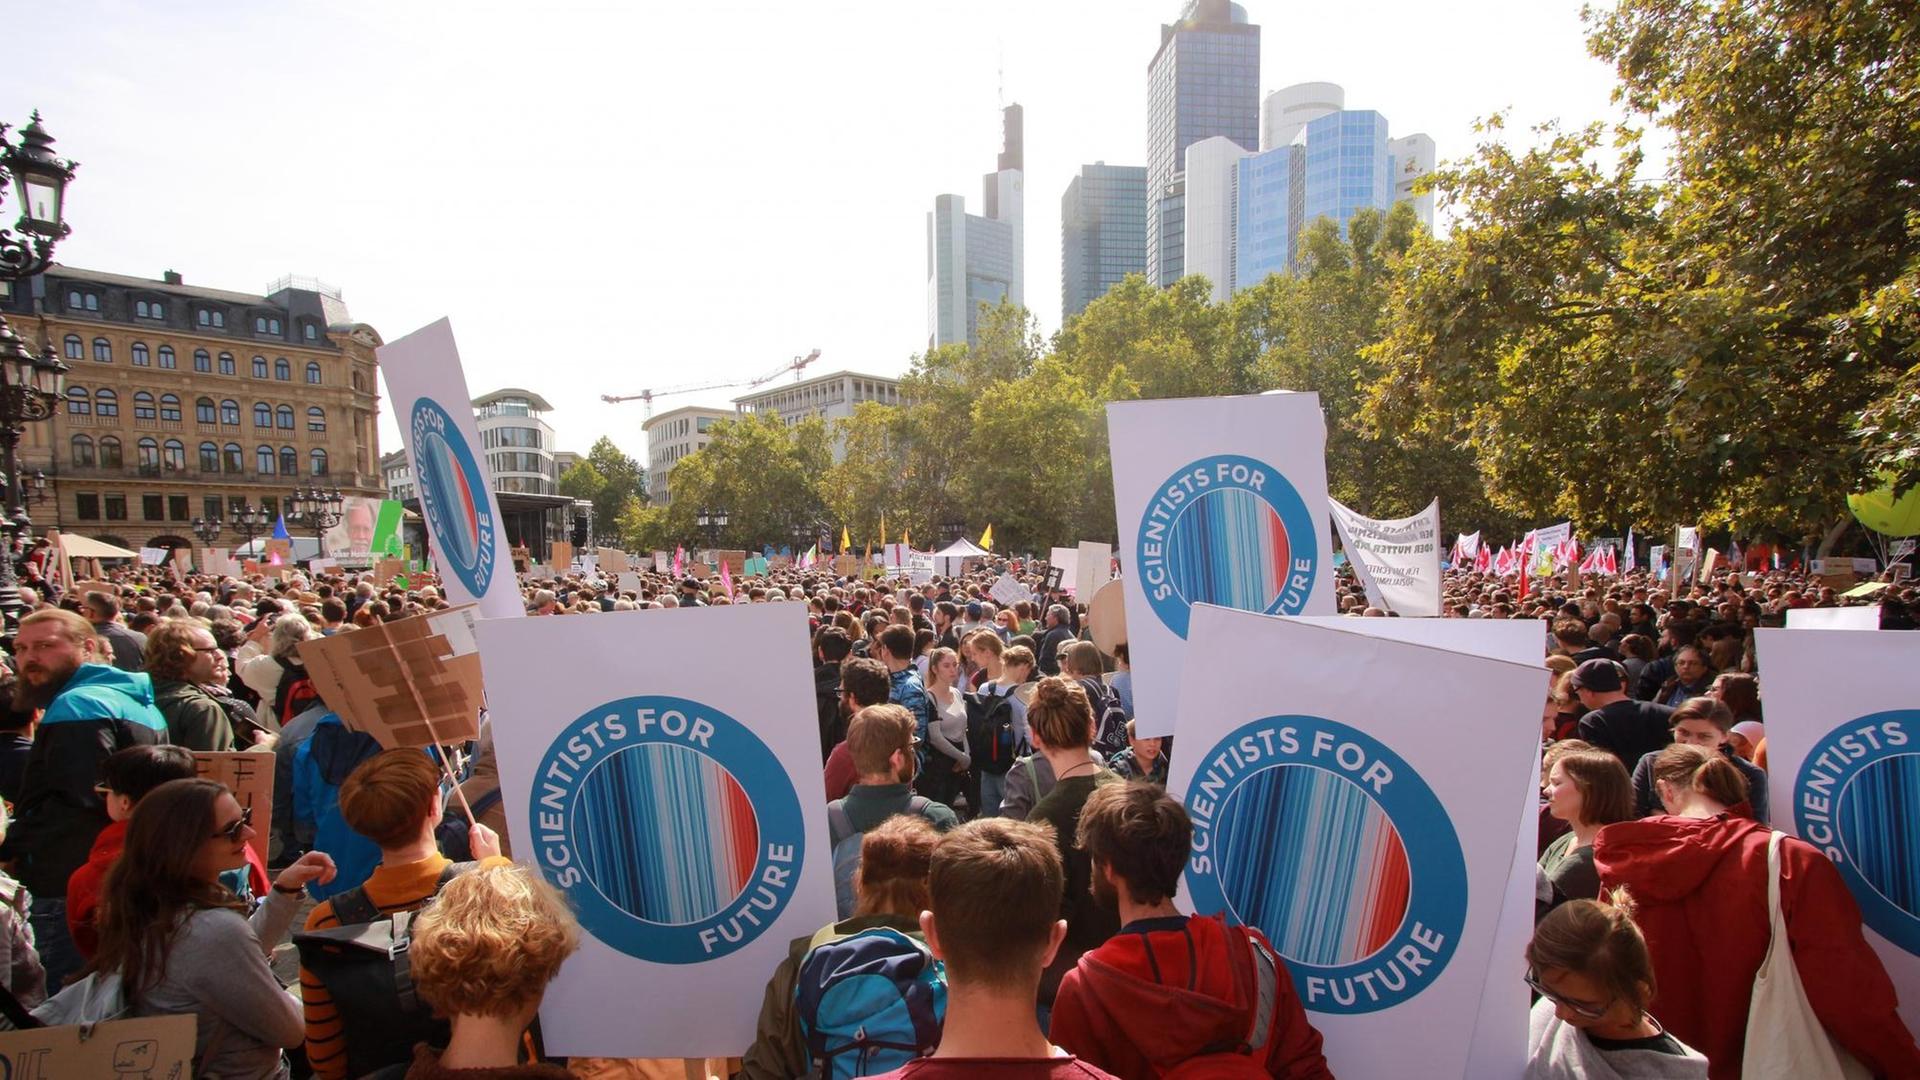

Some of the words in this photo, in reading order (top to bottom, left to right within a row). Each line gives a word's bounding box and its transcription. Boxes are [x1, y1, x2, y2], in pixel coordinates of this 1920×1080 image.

[412, 411, 443, 538] SCIENTISTS
[422, 406, 446, 436] FOR
[474, 511, 490, 592] FUTURE
[1144, 468, 1210, 602] SCIENTISTS
[1217, 463, 1266, 491] FOR
[1275, 558, 1311, 616] TURE
[540, 713, 627, 889] SCIENTISTS
[637, 708, 715, 747] FOR
[1190, 726, 1300, 875] SCIENTISTS
[1311, 730, 1395, 795] FOR
[1804, 721, 1909, 864] SCIENTISTS
[698, 842, 793, 954] FUTURE
[1306, 920, 1445, 1007] FUTURE
